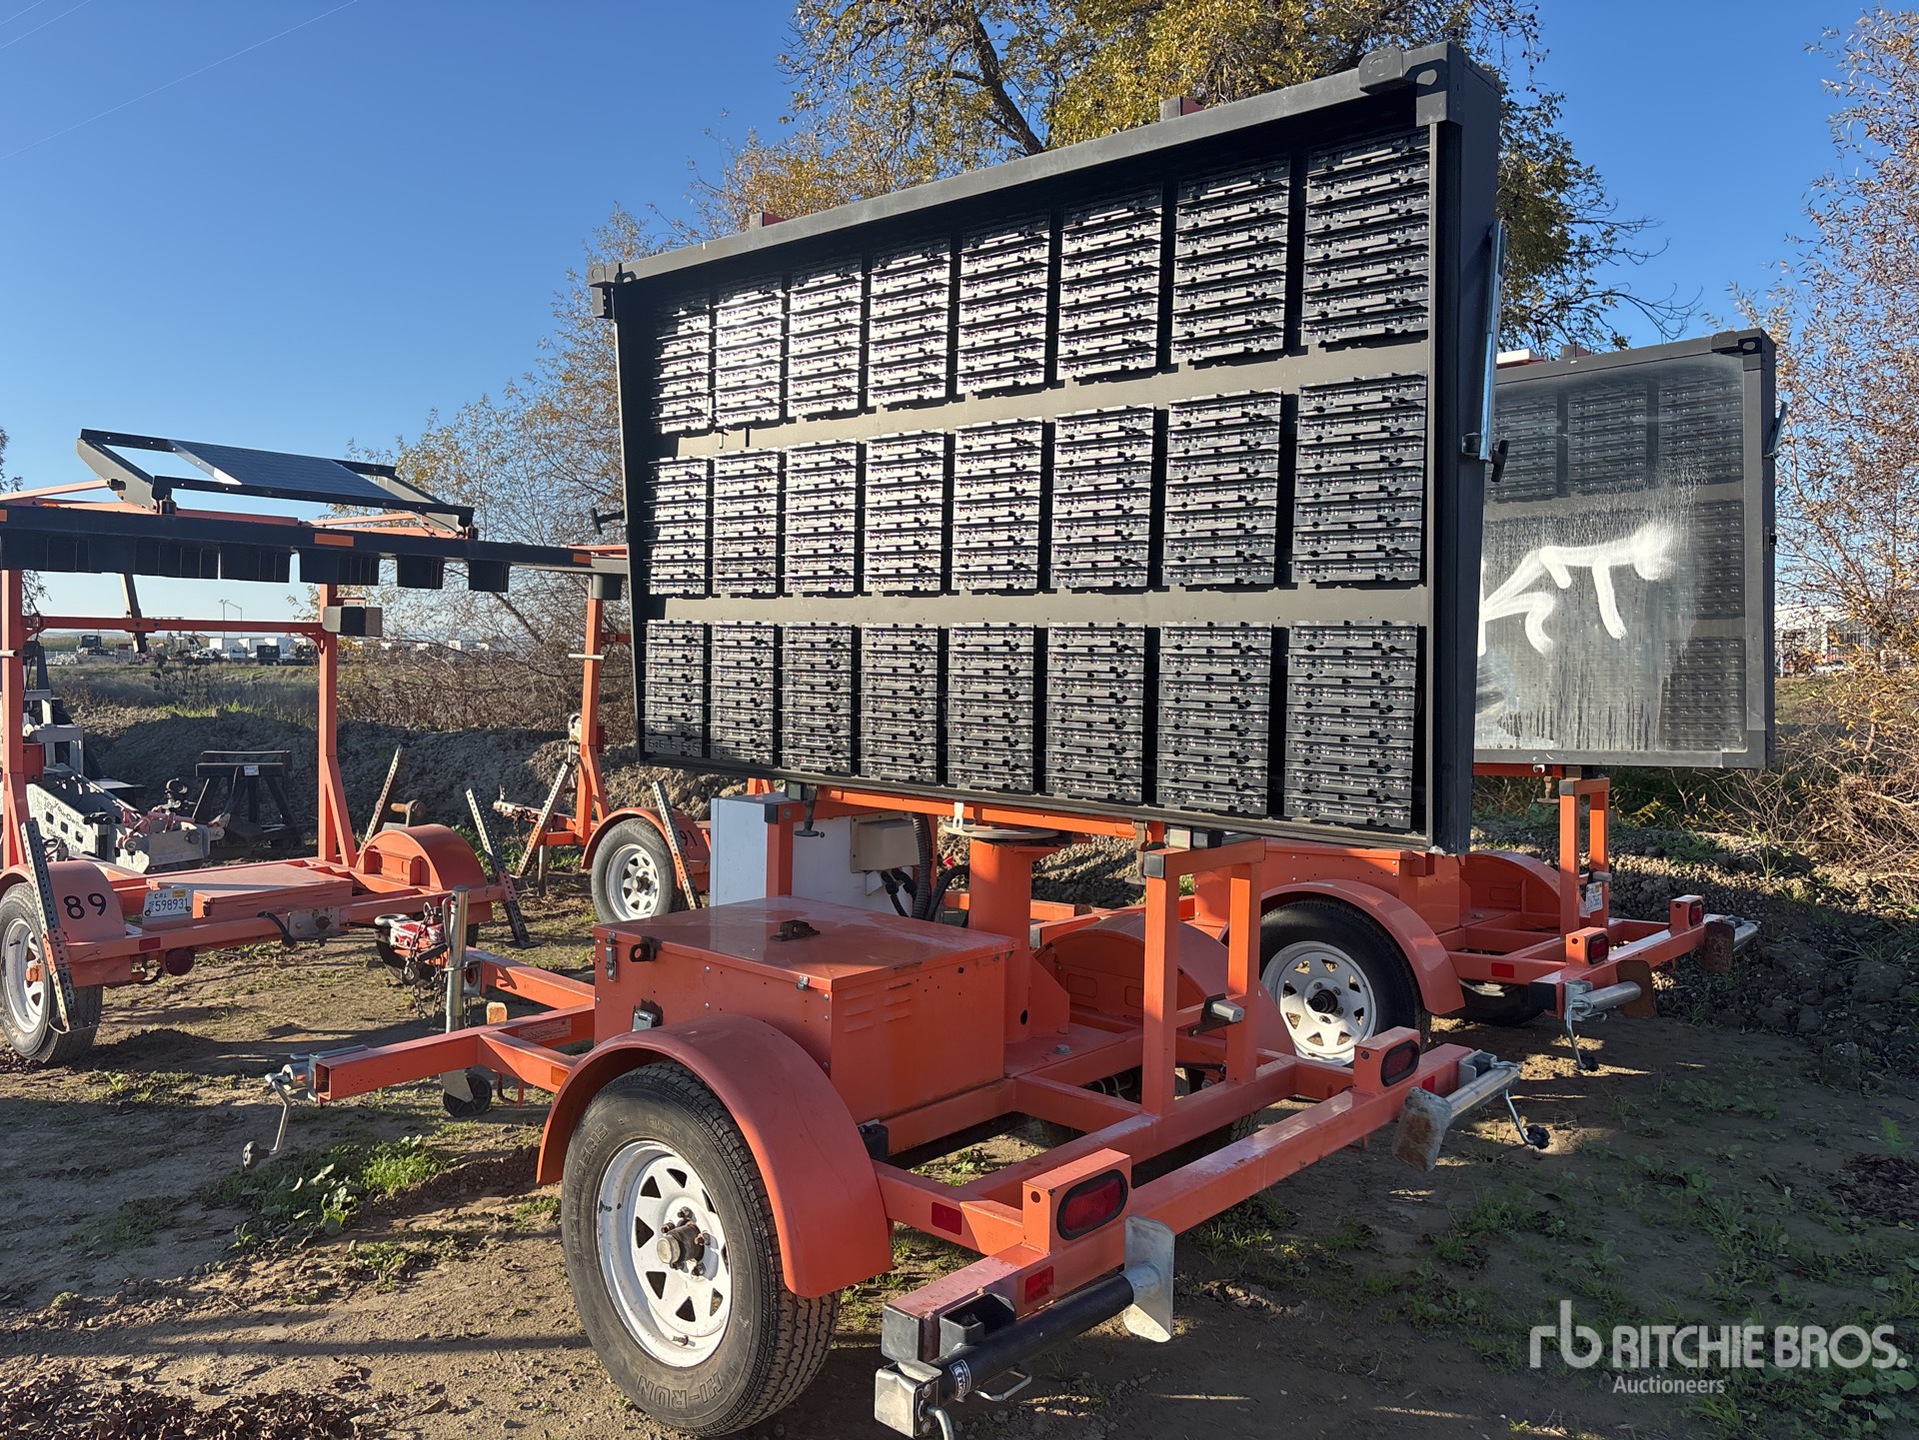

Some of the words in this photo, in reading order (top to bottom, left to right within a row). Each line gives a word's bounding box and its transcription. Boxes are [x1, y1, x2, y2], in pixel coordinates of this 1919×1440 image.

[63, 893, 107, 920] 89
[155, 898, 188, 912] 598931
[637, 1370, 724, 1410] HI-RUN
